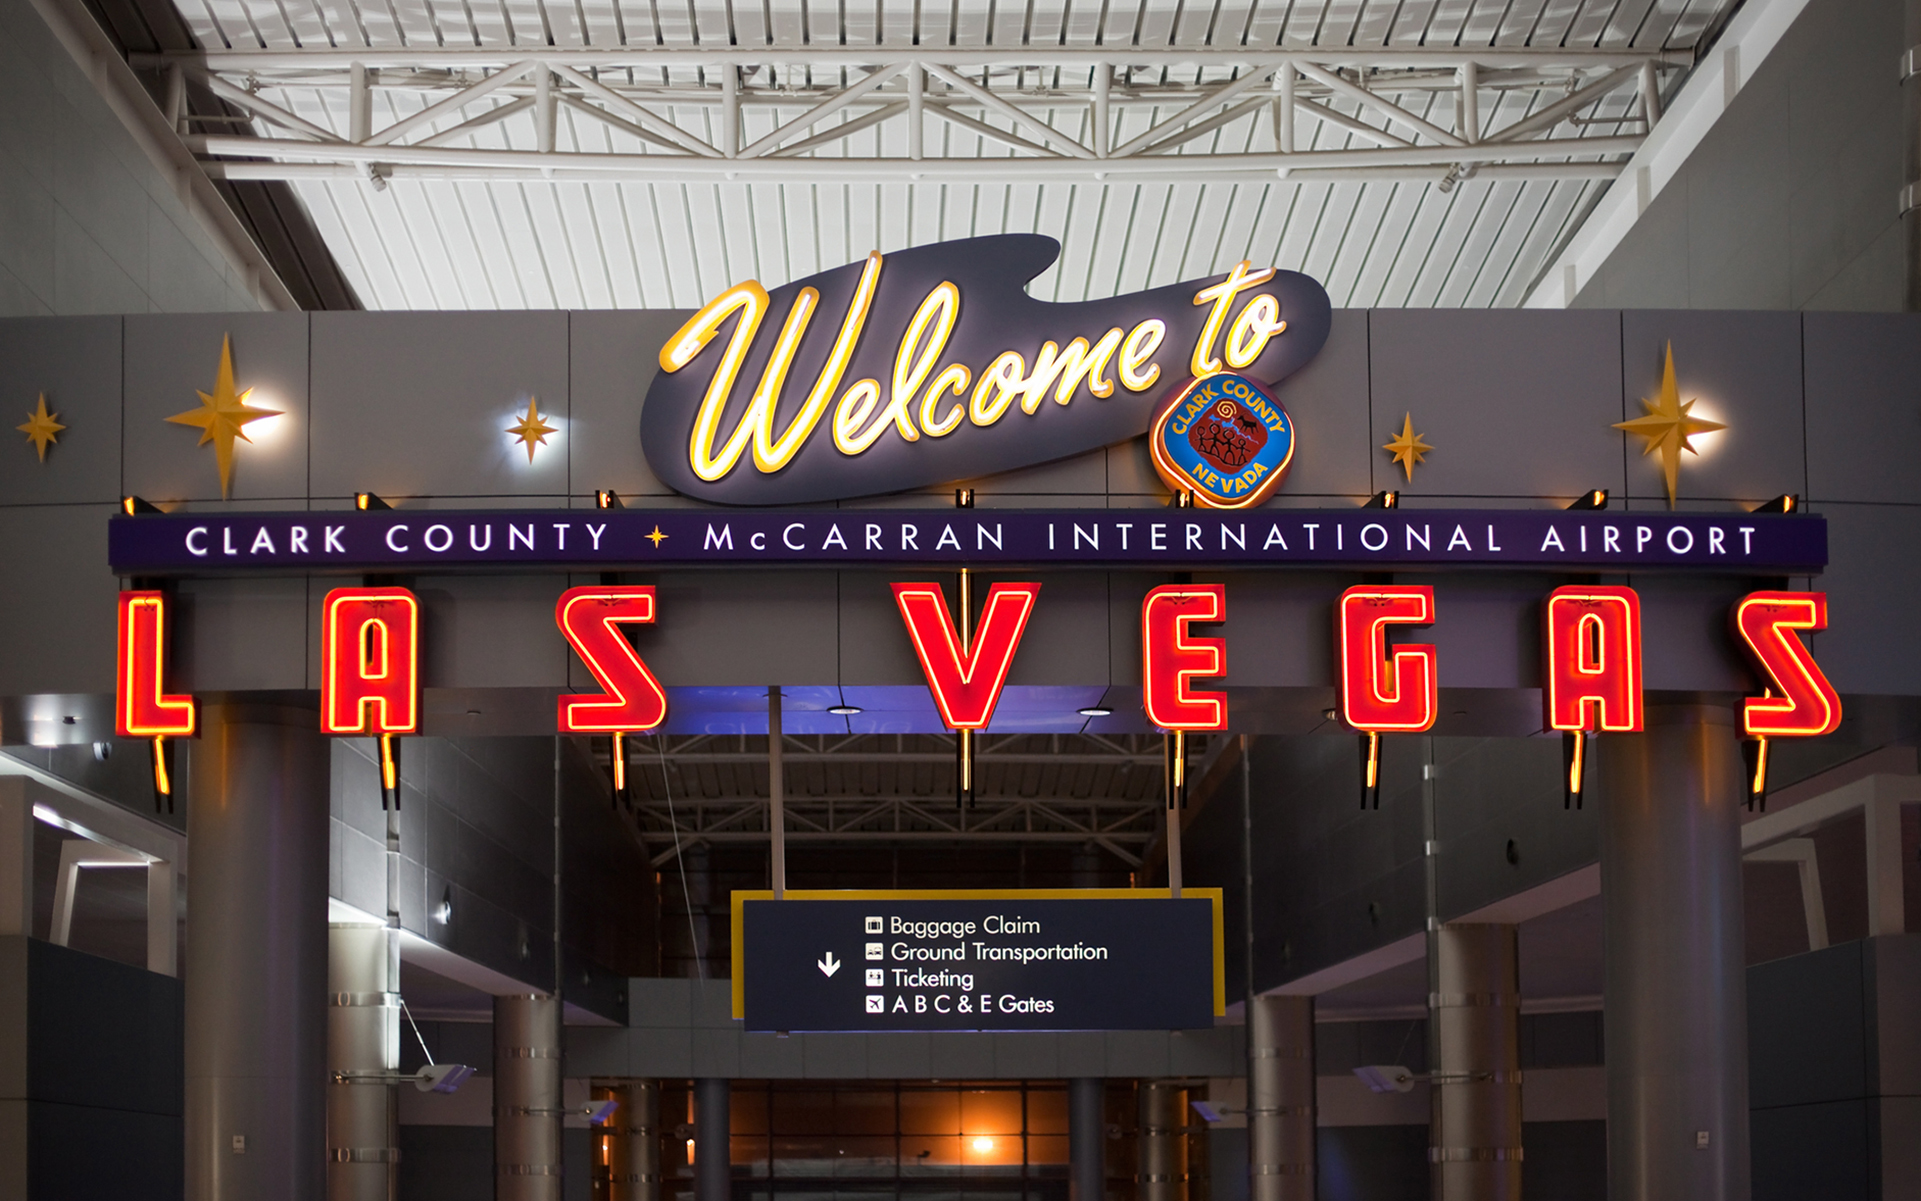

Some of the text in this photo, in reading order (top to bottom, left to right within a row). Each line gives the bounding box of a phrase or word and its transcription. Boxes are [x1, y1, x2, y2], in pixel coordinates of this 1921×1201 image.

[659, 249, 1287, 482] Welcome to
[1171, 379, 1286, 435] CLARK COUNTY
[1191, 462, 1269, 494] NEVADA
[184, 522, 1757, 557] CLARK COUNTY McCARRAN INTERNATIONAL AIRPORT
[115, 582, 1843, 738] LAS VEGAS
[890, 914, 1041, 939] Baggage Claim
[890, 941, 1108, 965] Ground Transportation
[891, 967, 974, 991] Ticketing
[891, 994, 1055, 1014] A B C & E Gates
